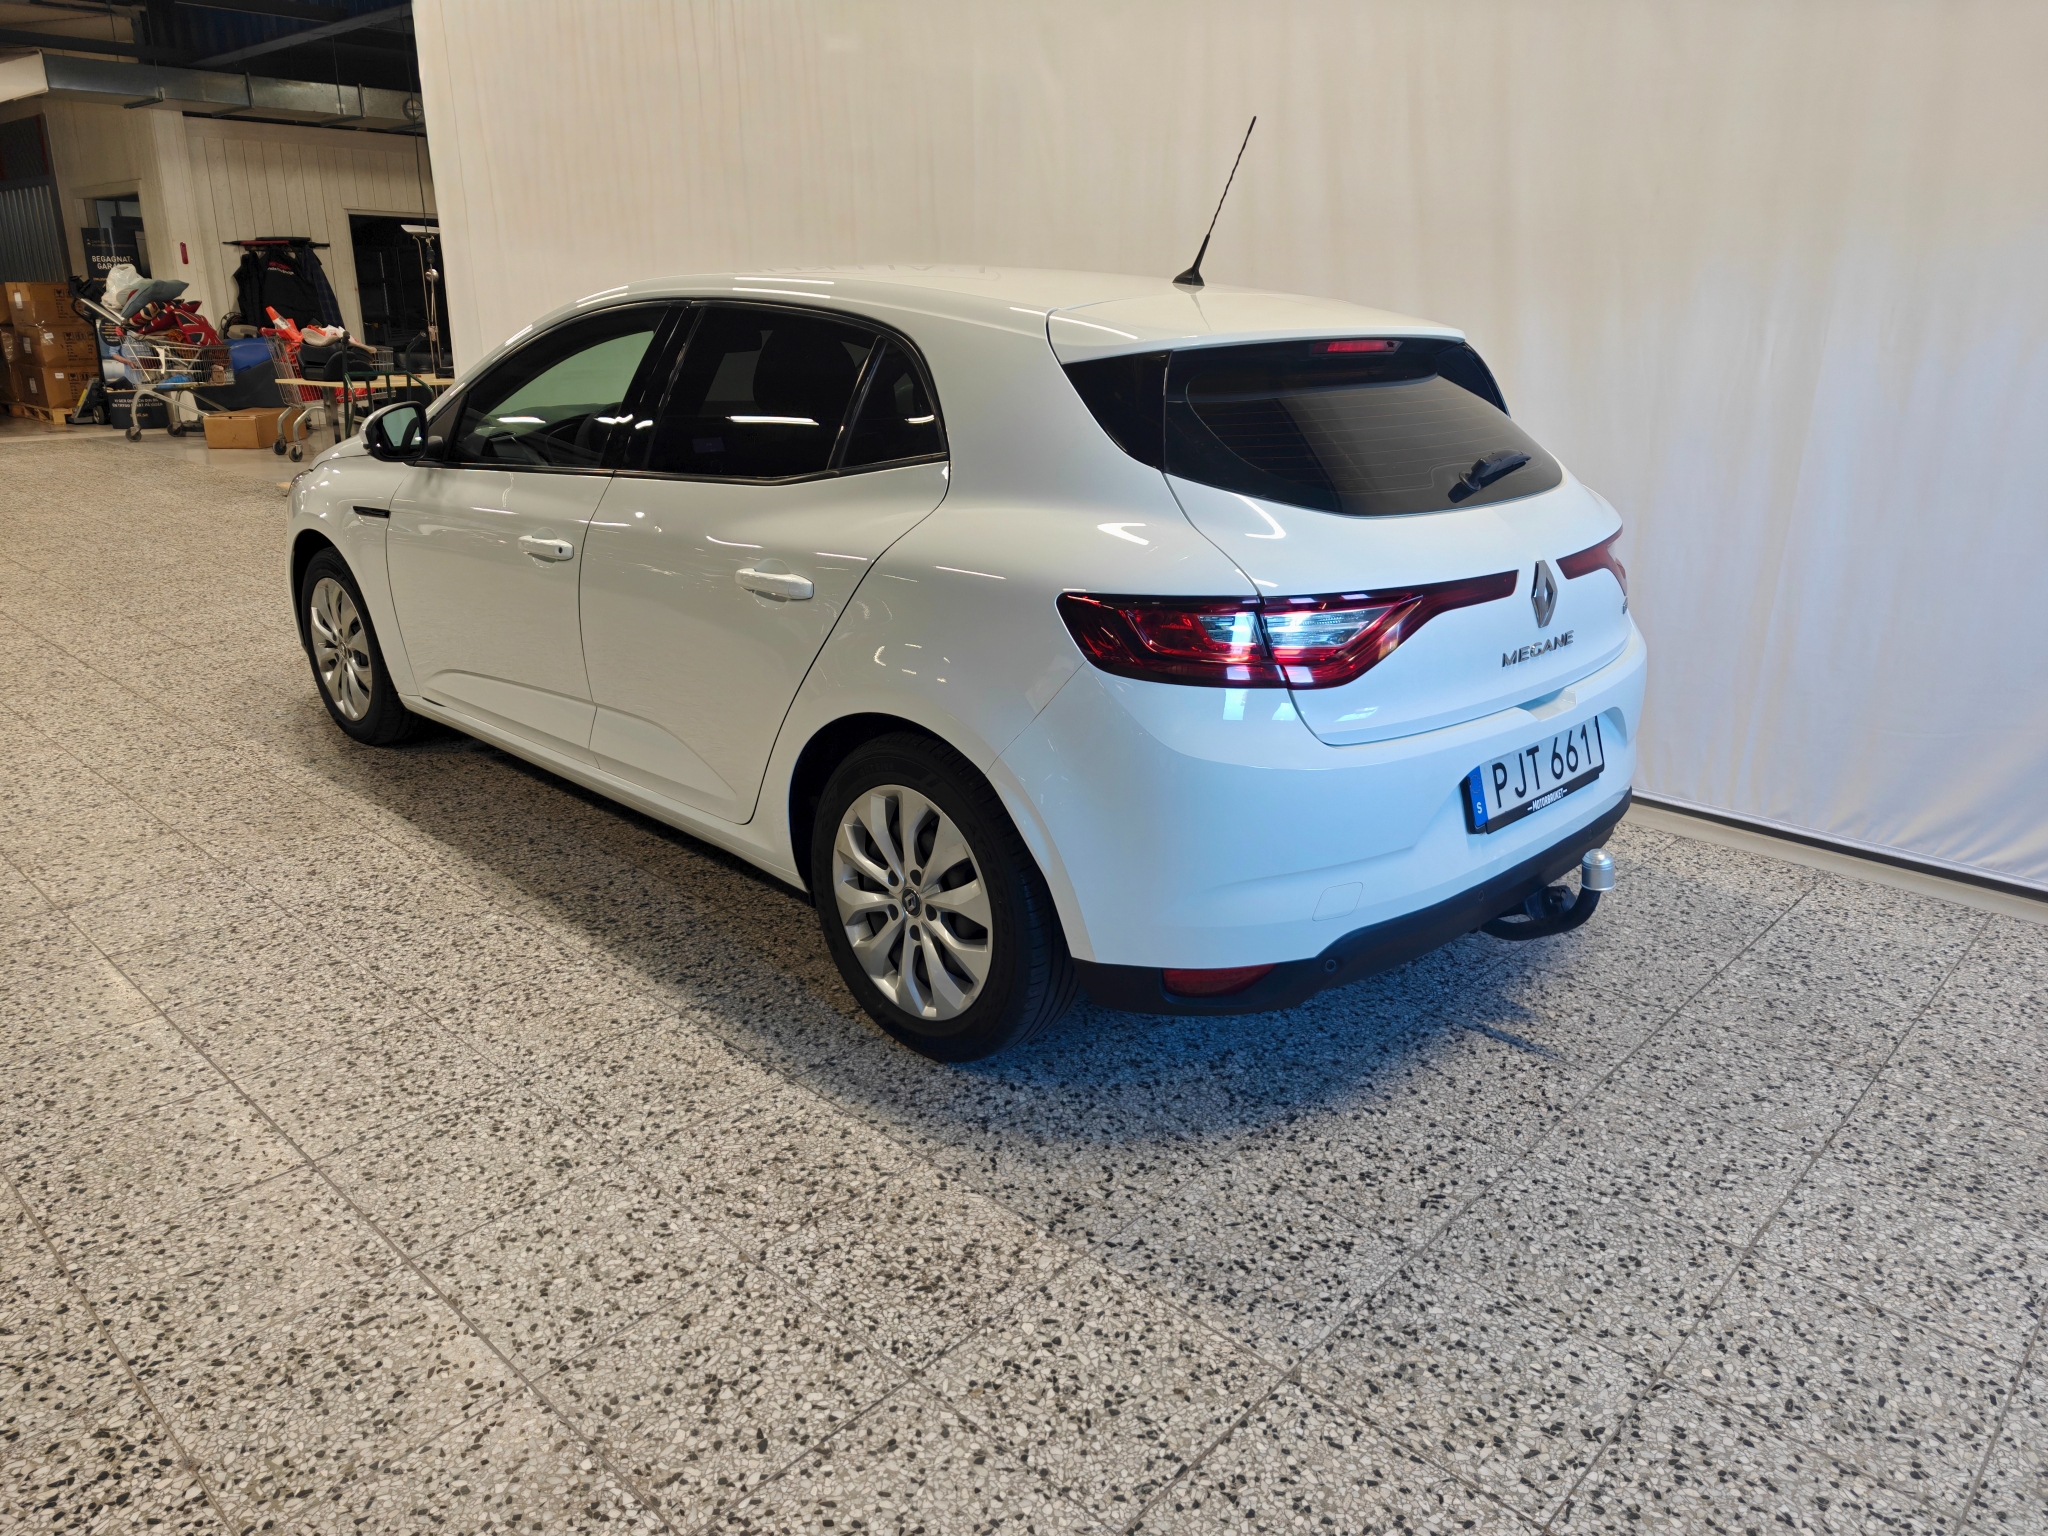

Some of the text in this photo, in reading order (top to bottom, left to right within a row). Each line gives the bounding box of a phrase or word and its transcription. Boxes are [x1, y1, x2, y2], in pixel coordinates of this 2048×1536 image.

[91, 255, 134, 263] BEGAGNAT-
[1502, 630, 1574, 667] MEGANE
[1476, 801, 1483, 815] S
